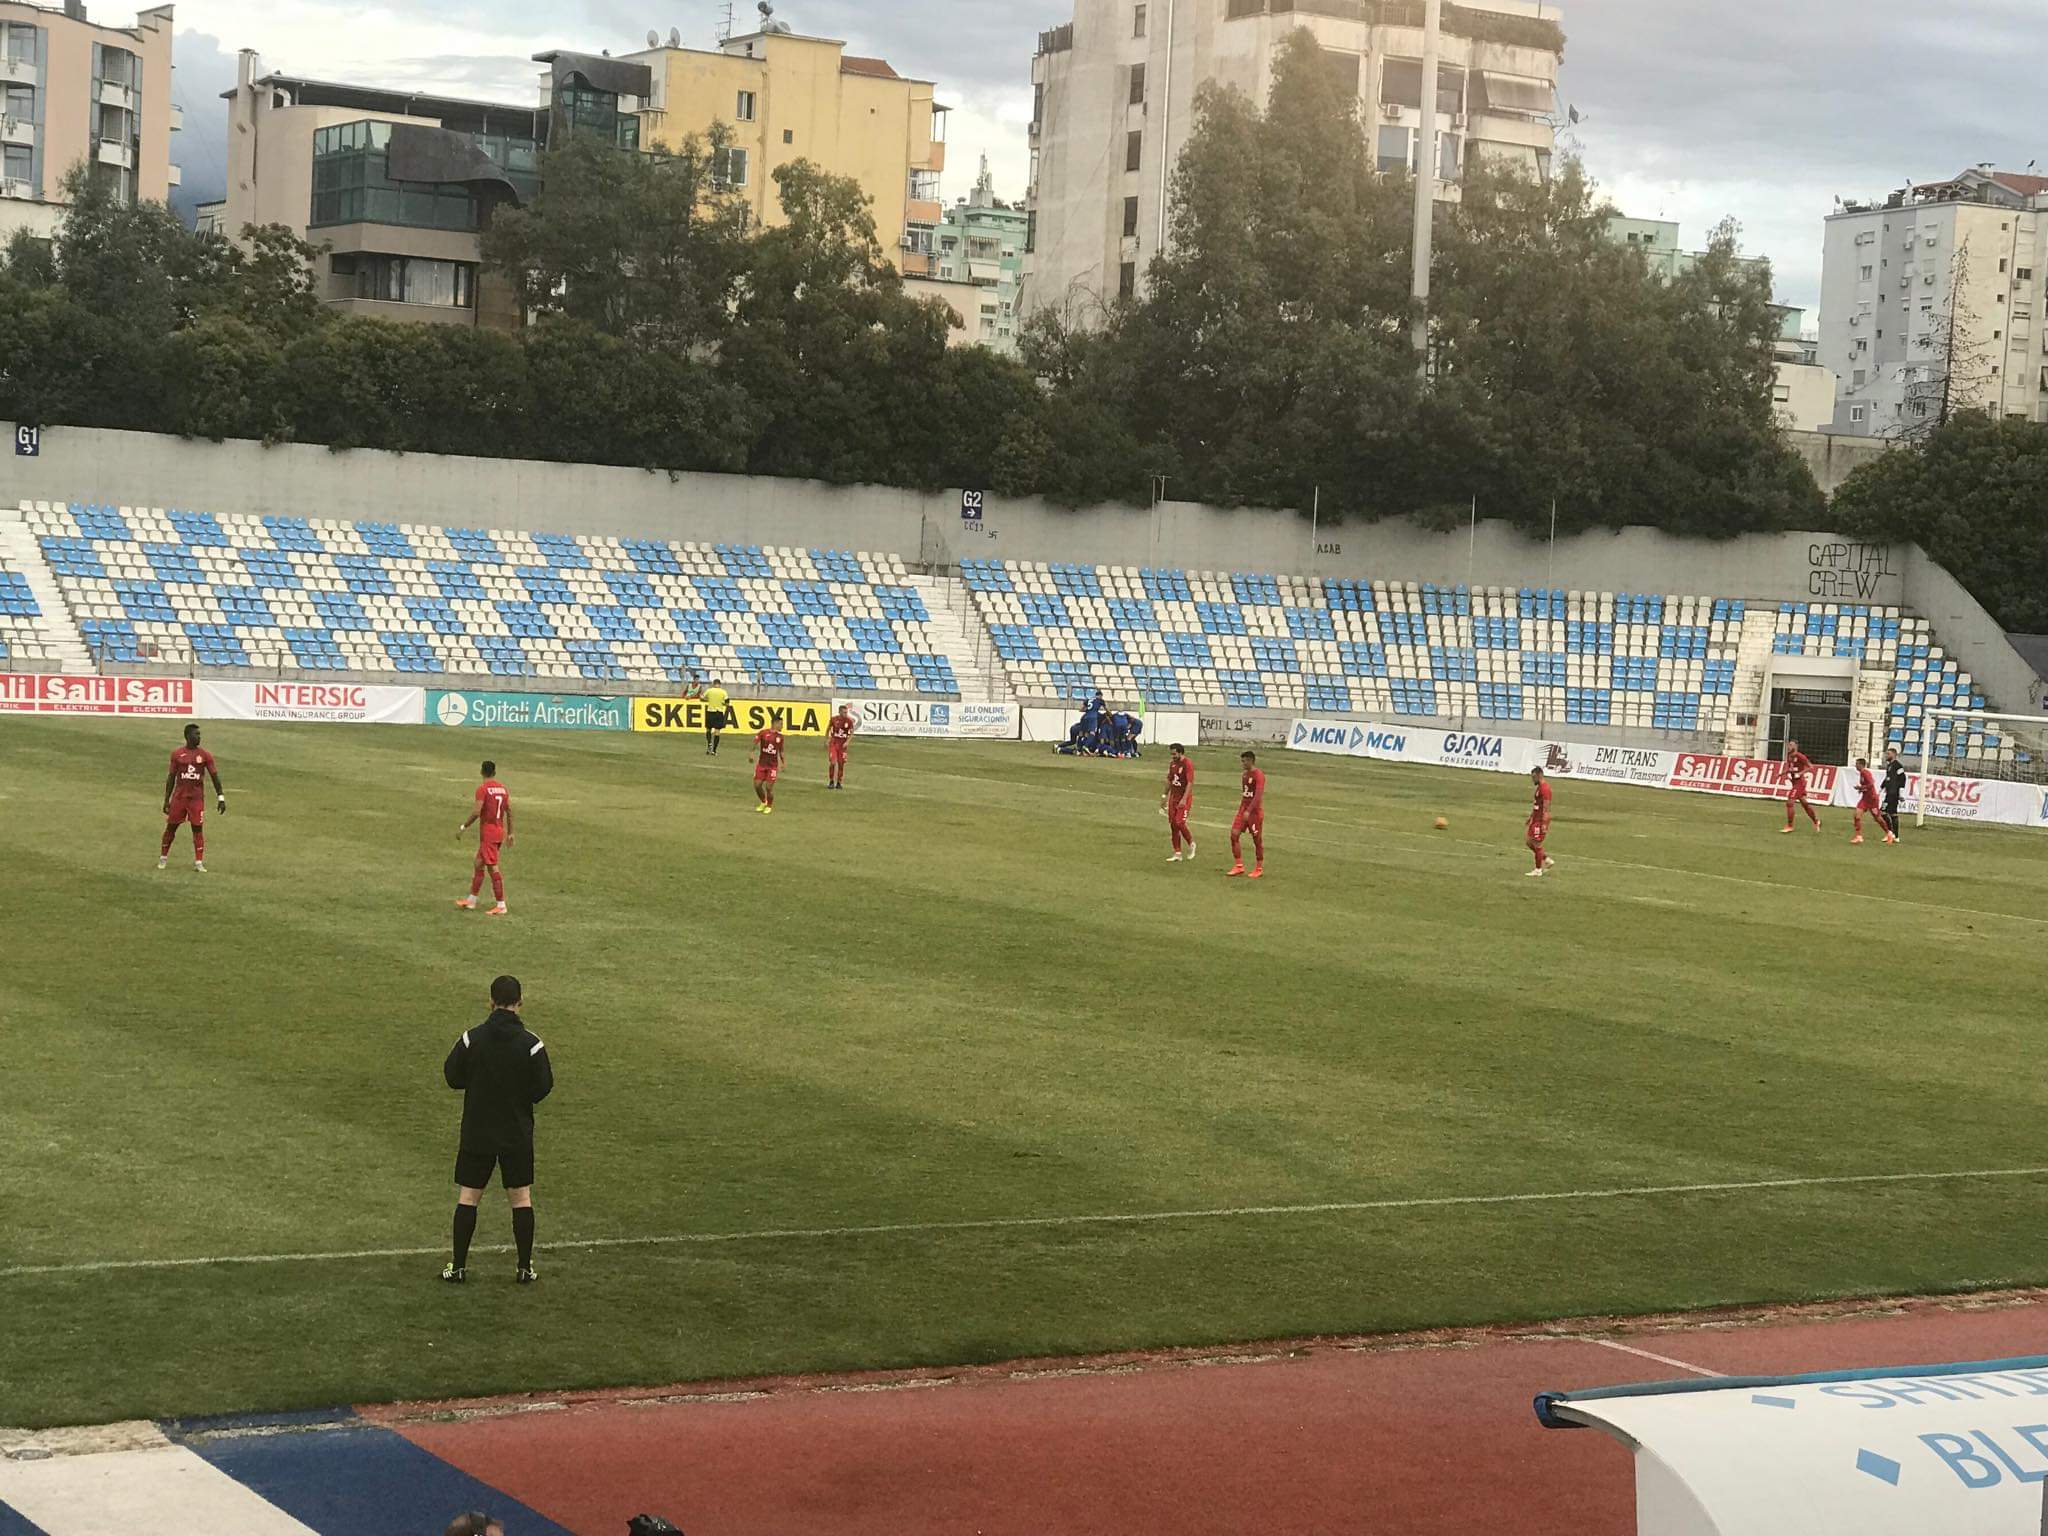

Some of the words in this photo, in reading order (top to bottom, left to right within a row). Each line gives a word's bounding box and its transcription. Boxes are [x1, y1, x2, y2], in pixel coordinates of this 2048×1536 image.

[19, 426, 37, 445] G1
[963, 490, 982, 507] G2
[1808, 543, 1897, 576] CAPITAL
[1809, 569, 1880, 599] CREW
[0, 677, 26, 699] li
[47, 678, 106, 701] Sali
[126, 680, 184, 703] Sali
[255, 684, 366, 707] INTERSIG
[255, 709, 286, 718] VIENNA
[289, 711, 337, 720] INSURANCE
[338, 712, 366, 720] GROUP
[472, 699, 529, 727] Spitali
[534, 702, 620, 726] Amerikan
[863, 702, 928, 722] SIGAL
[1087, 699, 1095, 710] 5
[645, 703, 740, 729] SKEA
[748, 706, 820, 732] SYLA
[1310, 727, 1346, 745] MCN
[1366, 731, 1407, 752] MCN
[1443, 733, 1502, 757] GJOKA
[1595, 747, 1618, 764] EMI
[1621, 750, 1659, 767] TRANS
[1577, 762, 1628, 779] International
[1630, 768, 1668, 783] Transport
[1679, 756, 1722, 781] Sali
[1731, 760, 1774, 786] Sali
[495, 795, 503, 819] 7
[1952, 807, 1978, 817] GROUP
